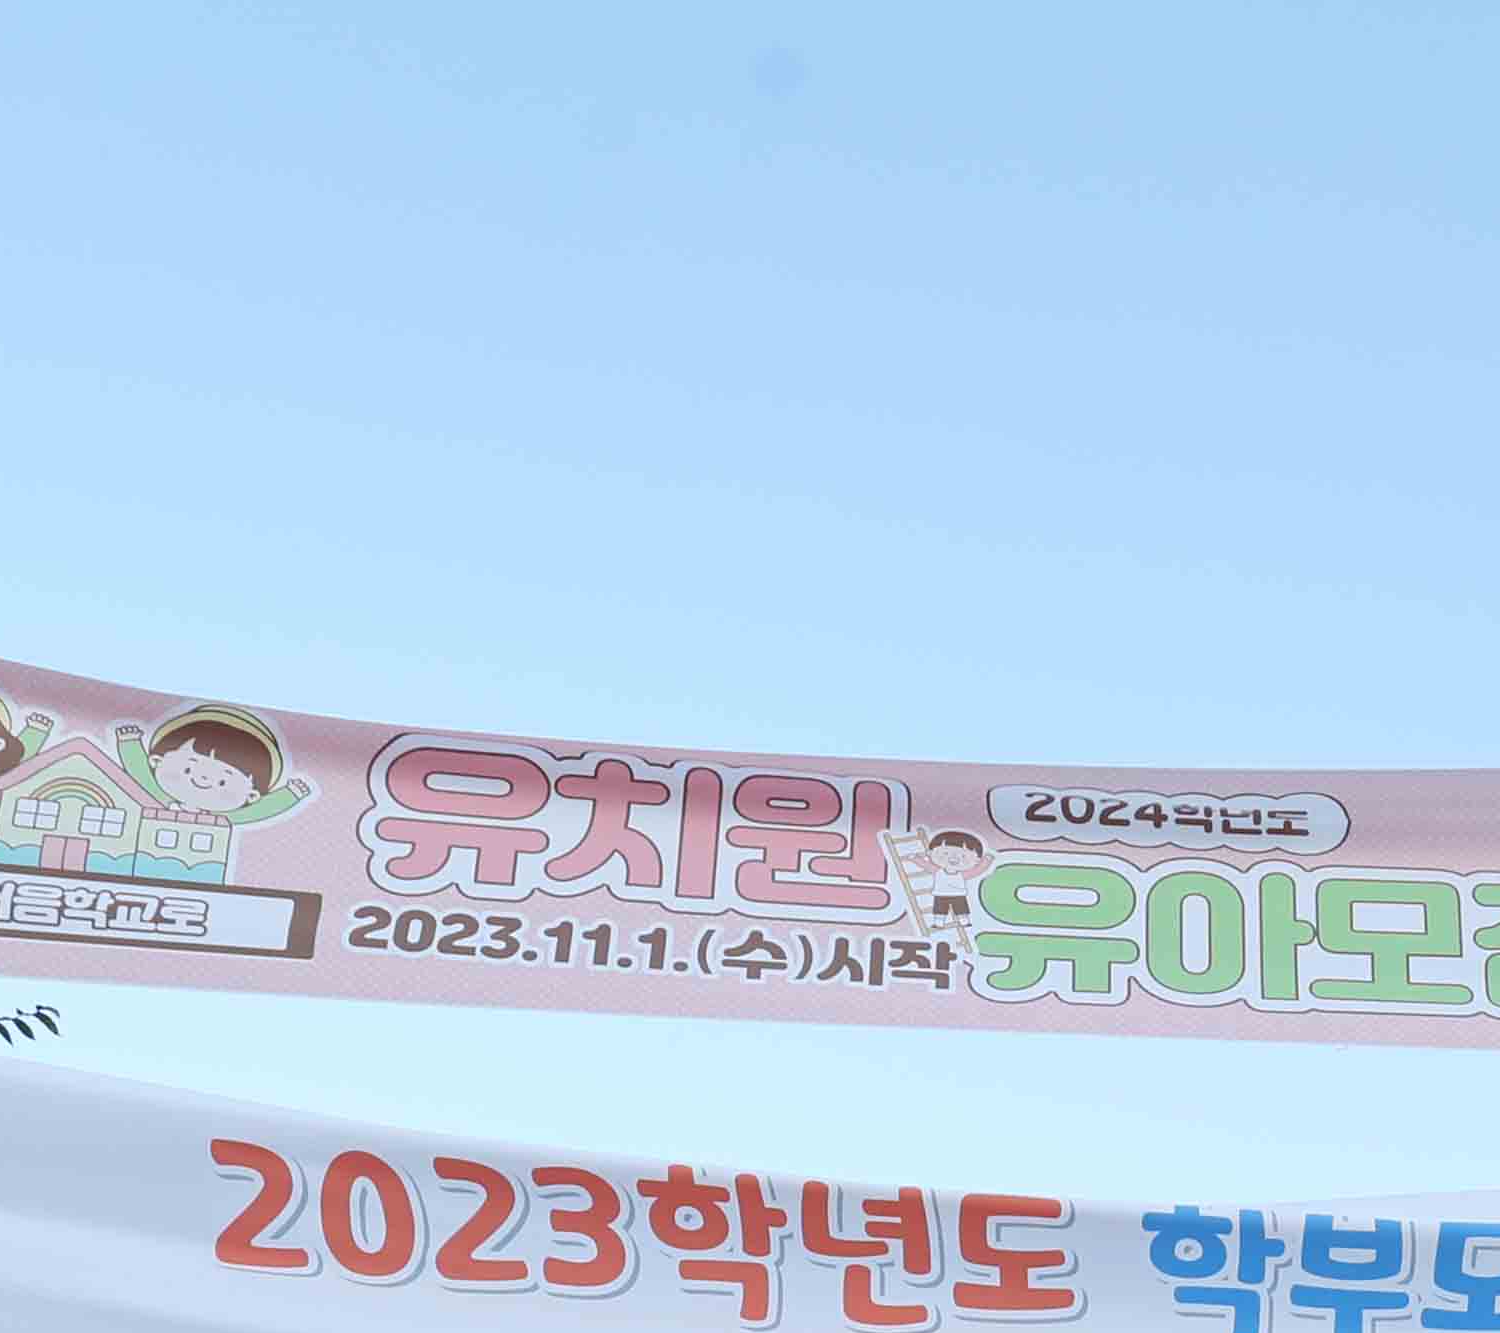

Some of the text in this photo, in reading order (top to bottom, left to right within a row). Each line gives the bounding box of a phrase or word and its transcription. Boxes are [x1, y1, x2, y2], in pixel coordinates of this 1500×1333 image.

[376, 747, 892, 909] 유치원
[1023, 791, 1310, 836] 2024학년도
[210, 1137, 1077, 1327] 2023학년도
